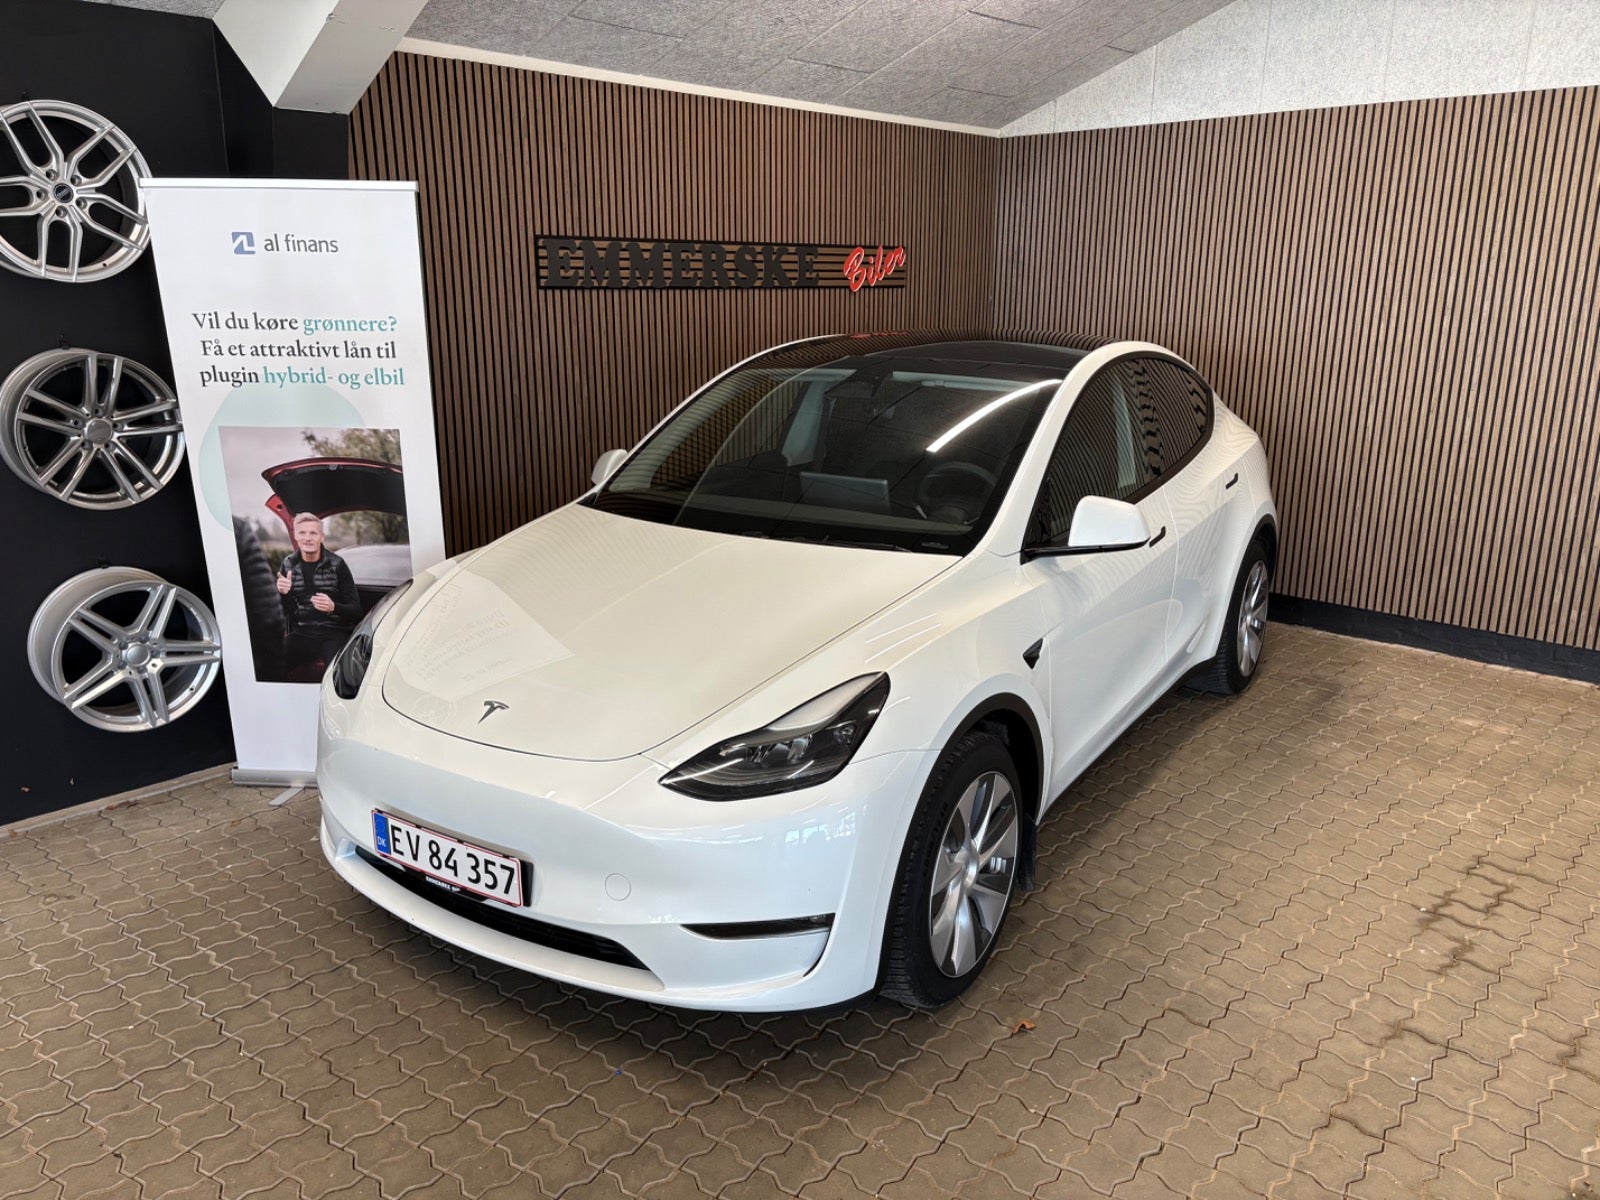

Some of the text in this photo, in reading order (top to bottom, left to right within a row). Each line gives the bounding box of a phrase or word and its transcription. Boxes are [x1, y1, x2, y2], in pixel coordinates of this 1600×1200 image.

[263, 233, 339, 253] al finans
[543, 238, 820, 288] EMMERSKE
[192, 311, 398, 335] Vil du køre grønnere?
[200, 338, 397, 359] Få et attraktivt lån til
[199, 365, 405, 390] plugin hybrid- og elbil
[377, 836, 387, 848] DK
[390, 824, 420, 862] EV
[428, 840, 459, 878] 84
[466, 852, 516, 895] 357
